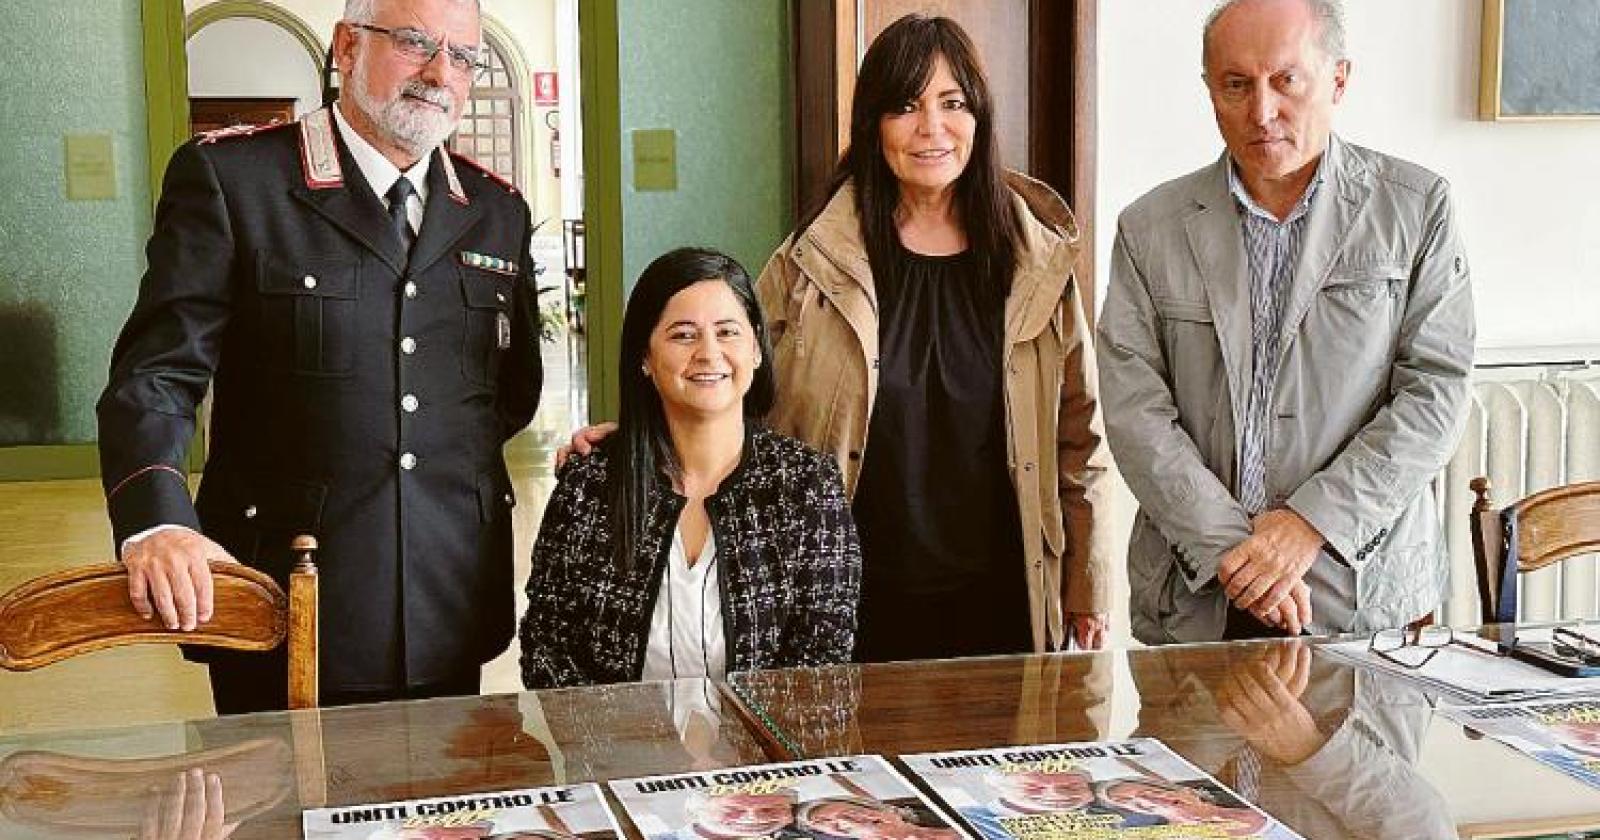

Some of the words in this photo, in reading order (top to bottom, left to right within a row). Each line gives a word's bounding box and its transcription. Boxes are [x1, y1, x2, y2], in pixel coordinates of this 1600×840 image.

[635, 776, 708, 793] UNITI
[332, 808, 407, 823] UNITI
[416, 795, 532, 814] CONTRO
[540, 789, 574, 803] LE
